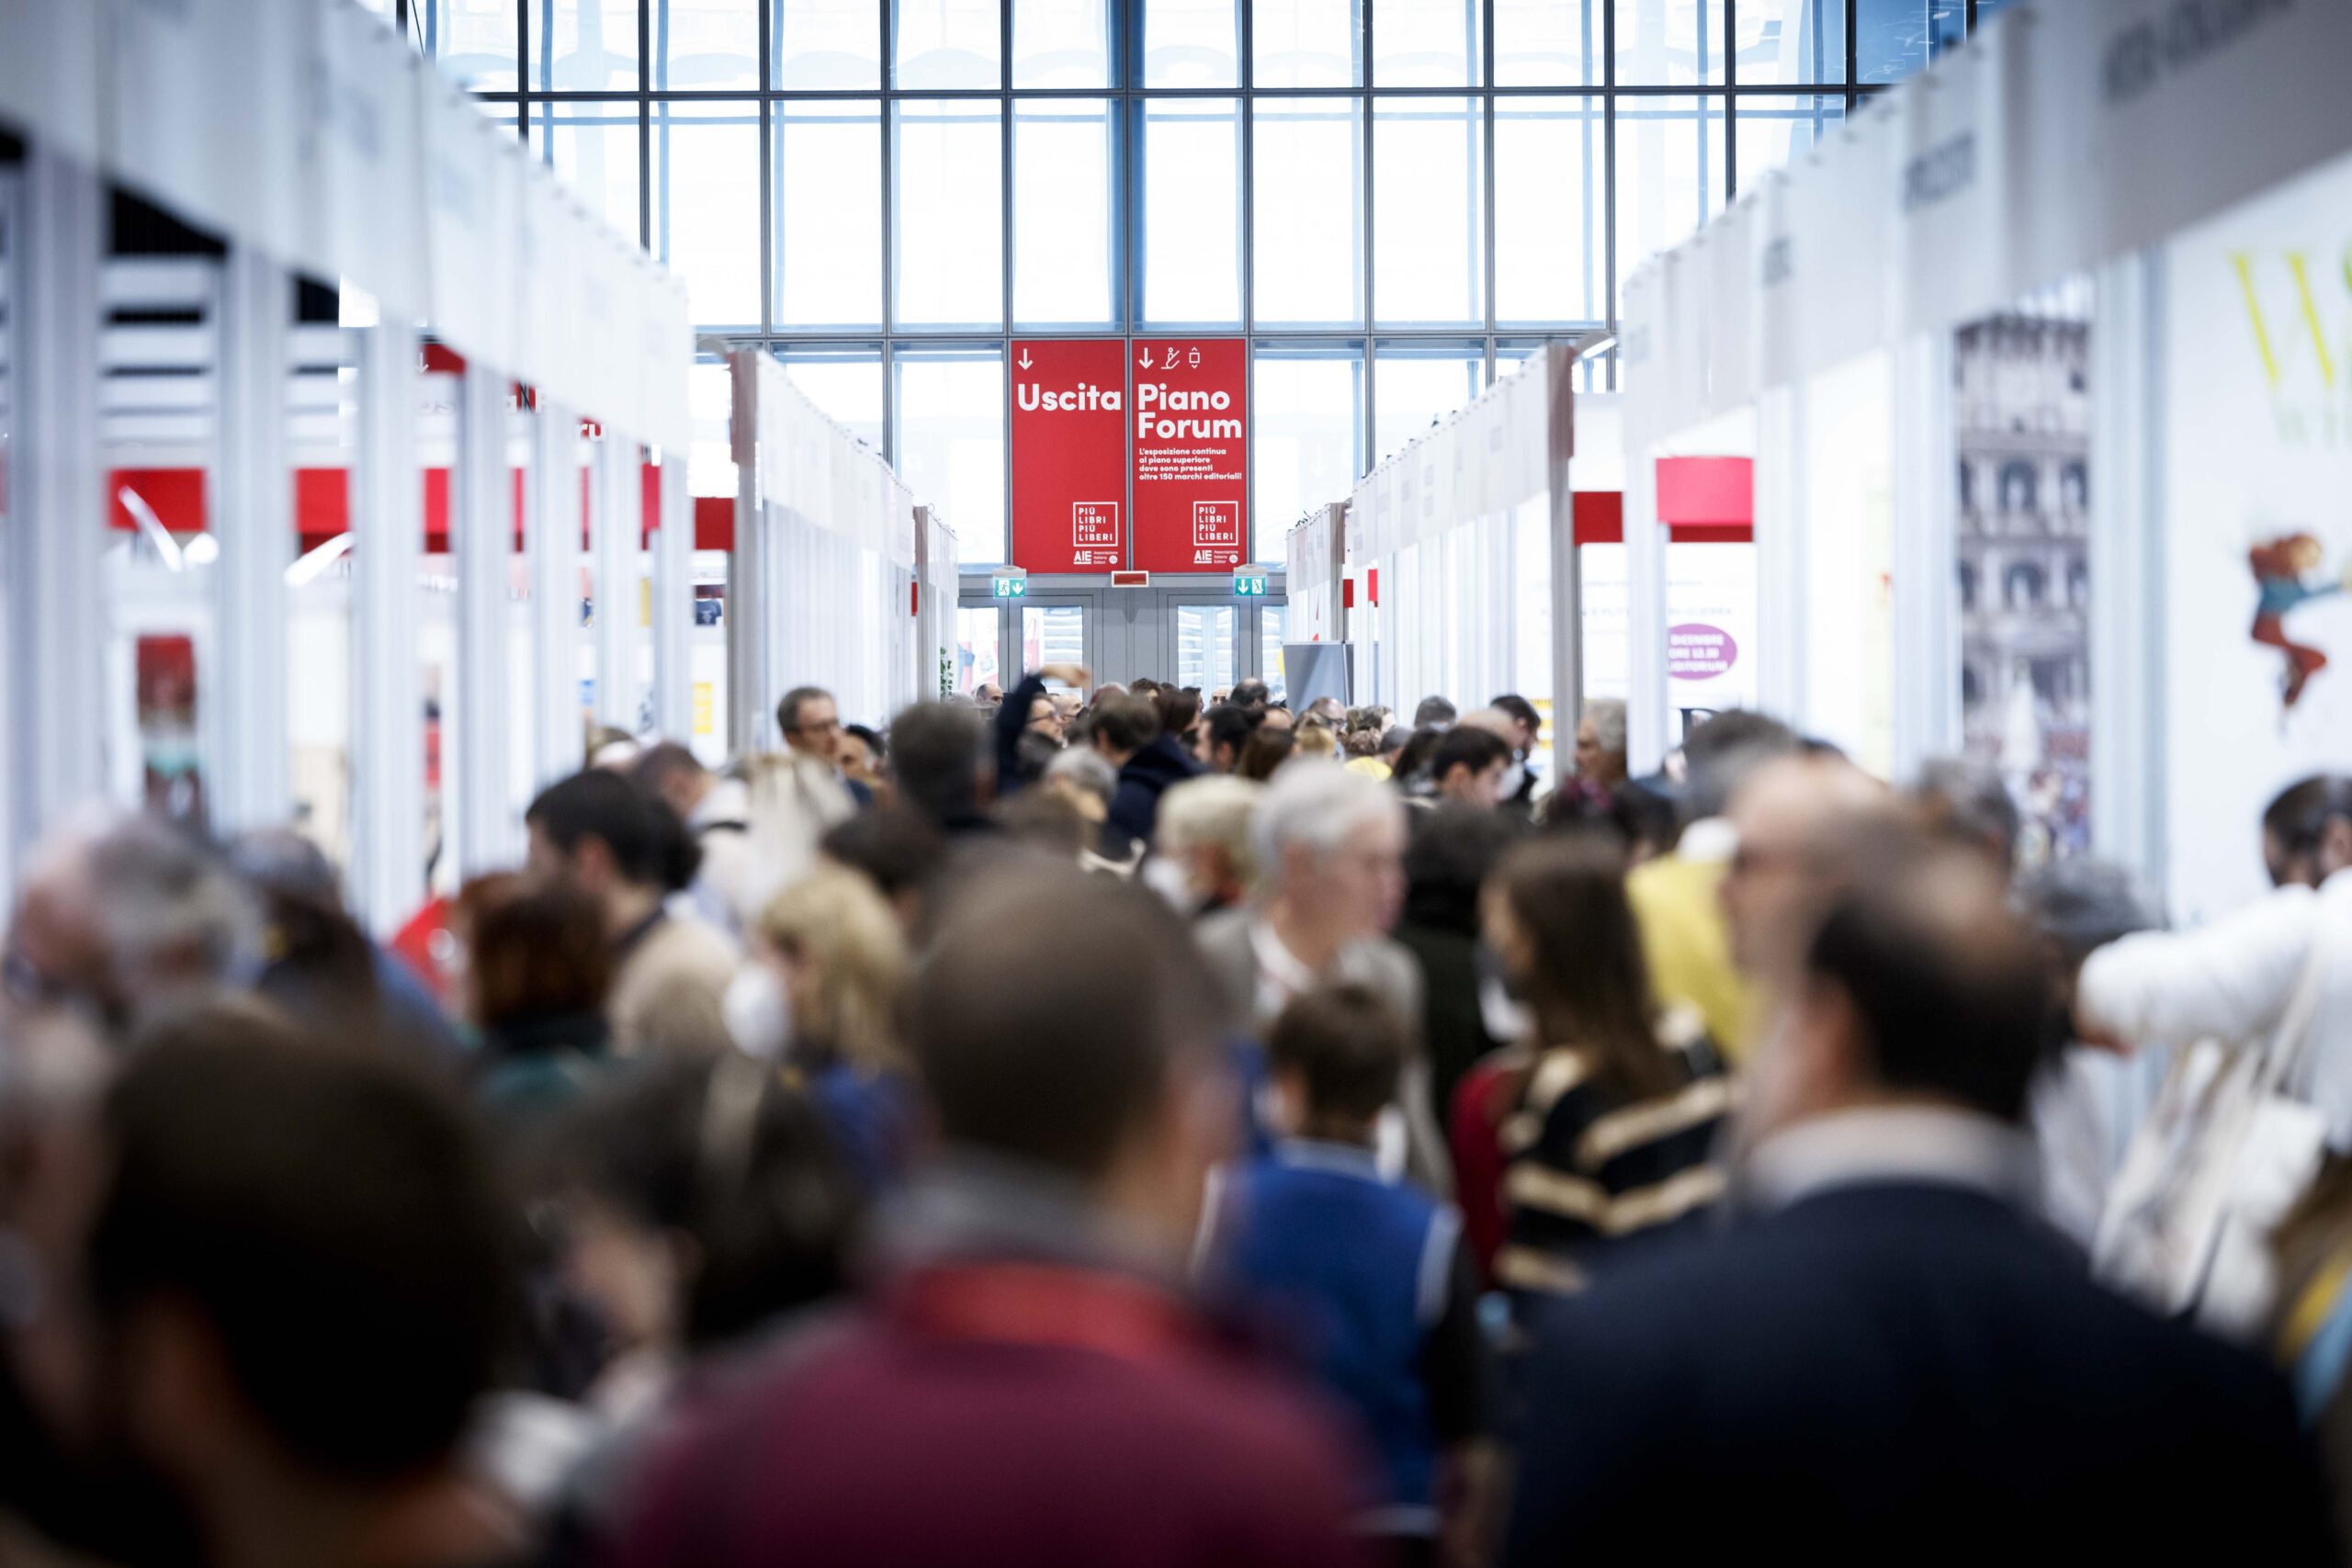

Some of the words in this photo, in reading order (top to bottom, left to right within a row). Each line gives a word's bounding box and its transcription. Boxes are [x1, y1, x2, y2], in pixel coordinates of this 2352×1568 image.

[1017, 382, 1121, 412] Uscita
[1138, 382, 1230, 411] Piano
[1138, 412, 1242, 439] Forum
[1139, 447, 1190, 457] L'esposizione
[1148, 456, 1171, 465] piano
[1172, 456, 1211, 465] superiore
[1181, 464, 1213, 473] presenti
[1079, 507, 1095, 515] PIÙ
[1199, 505, 1216, 514] PIÙ
[1079, 524, 1095, 533] PIÙ
[1199, 523, 1216, 532] PIÙ
[1073, 551, 1091, 562] AIE
[1193, 550, 1212, 561] AIE
